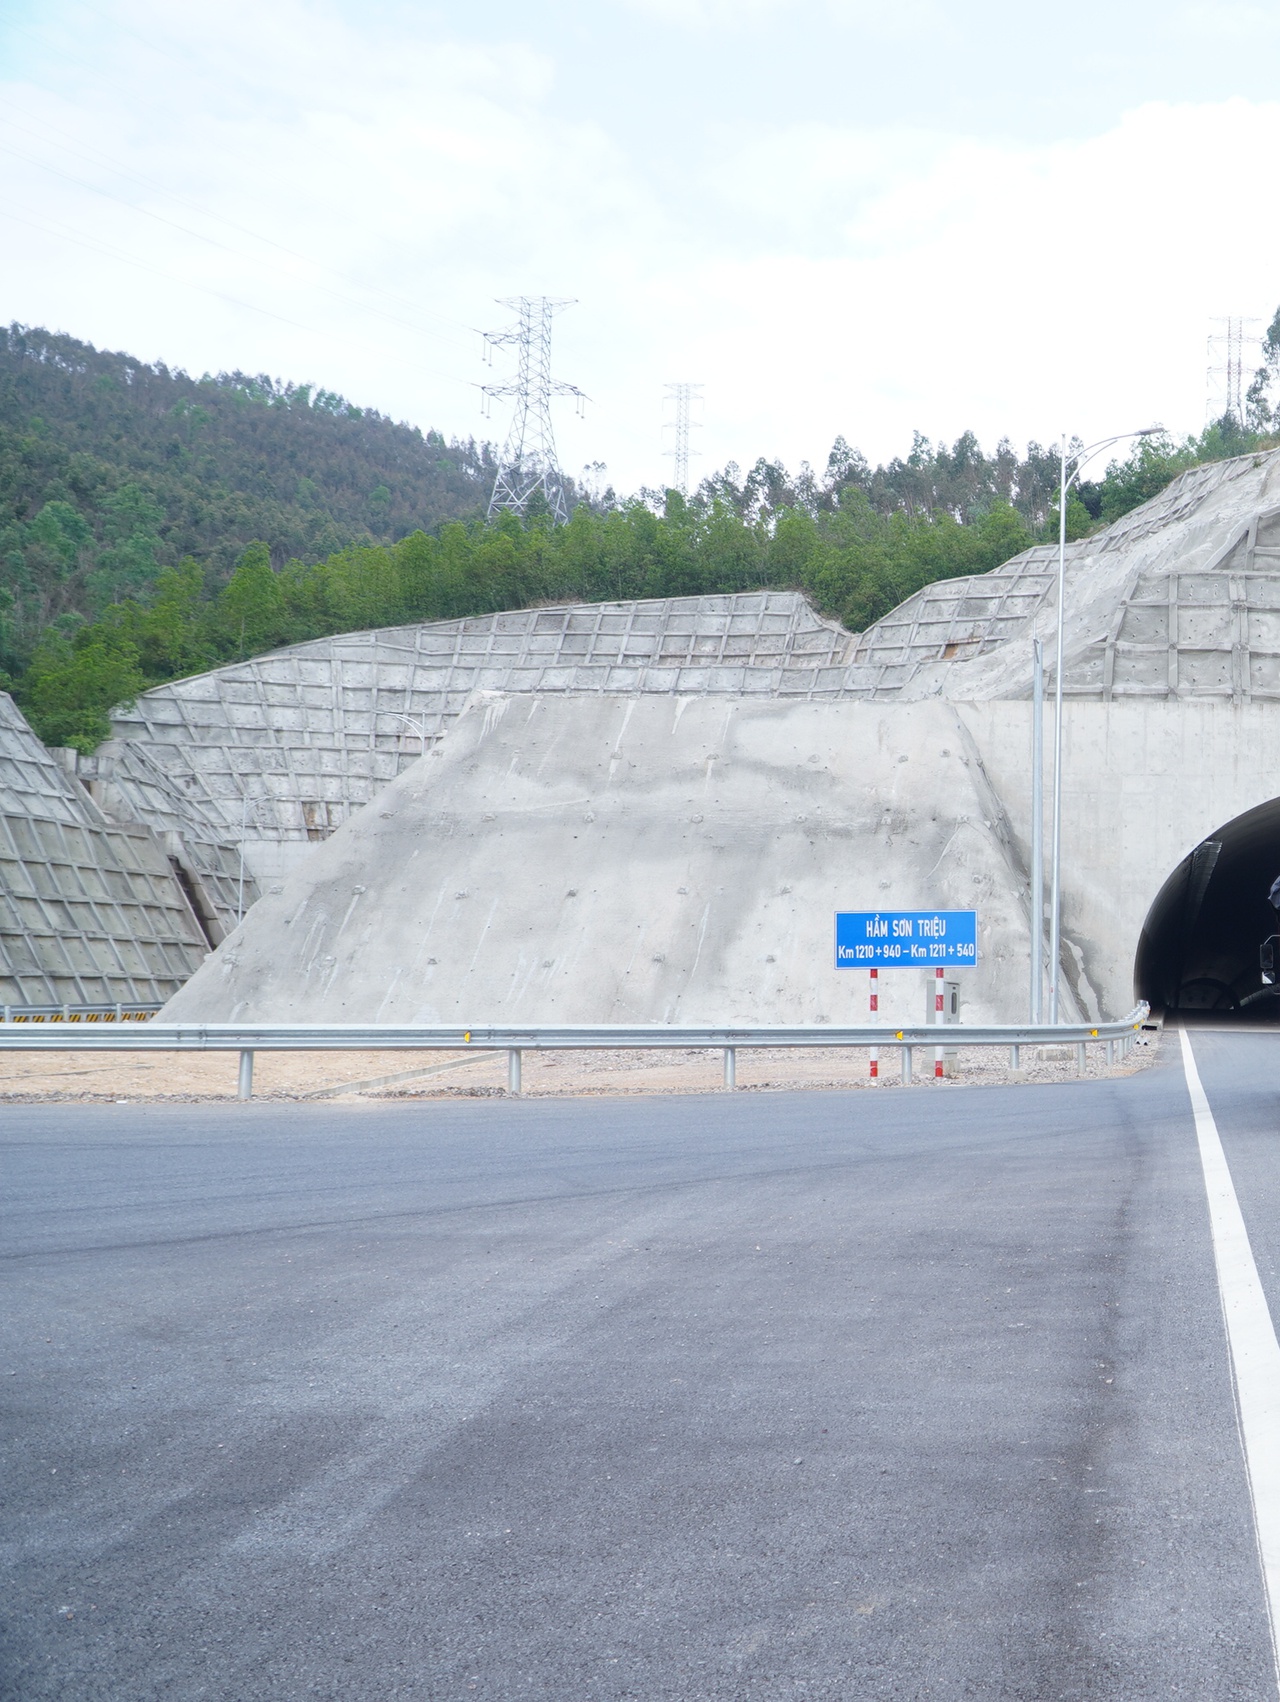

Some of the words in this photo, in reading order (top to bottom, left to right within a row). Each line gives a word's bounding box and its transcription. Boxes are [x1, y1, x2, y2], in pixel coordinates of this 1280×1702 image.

[866, 914, 888, 938] HẦM
[892, 918, 913, 937] SƠN
[917, 916, 946, 939] TRIỆU
[911, 944, 927, 958] Km
